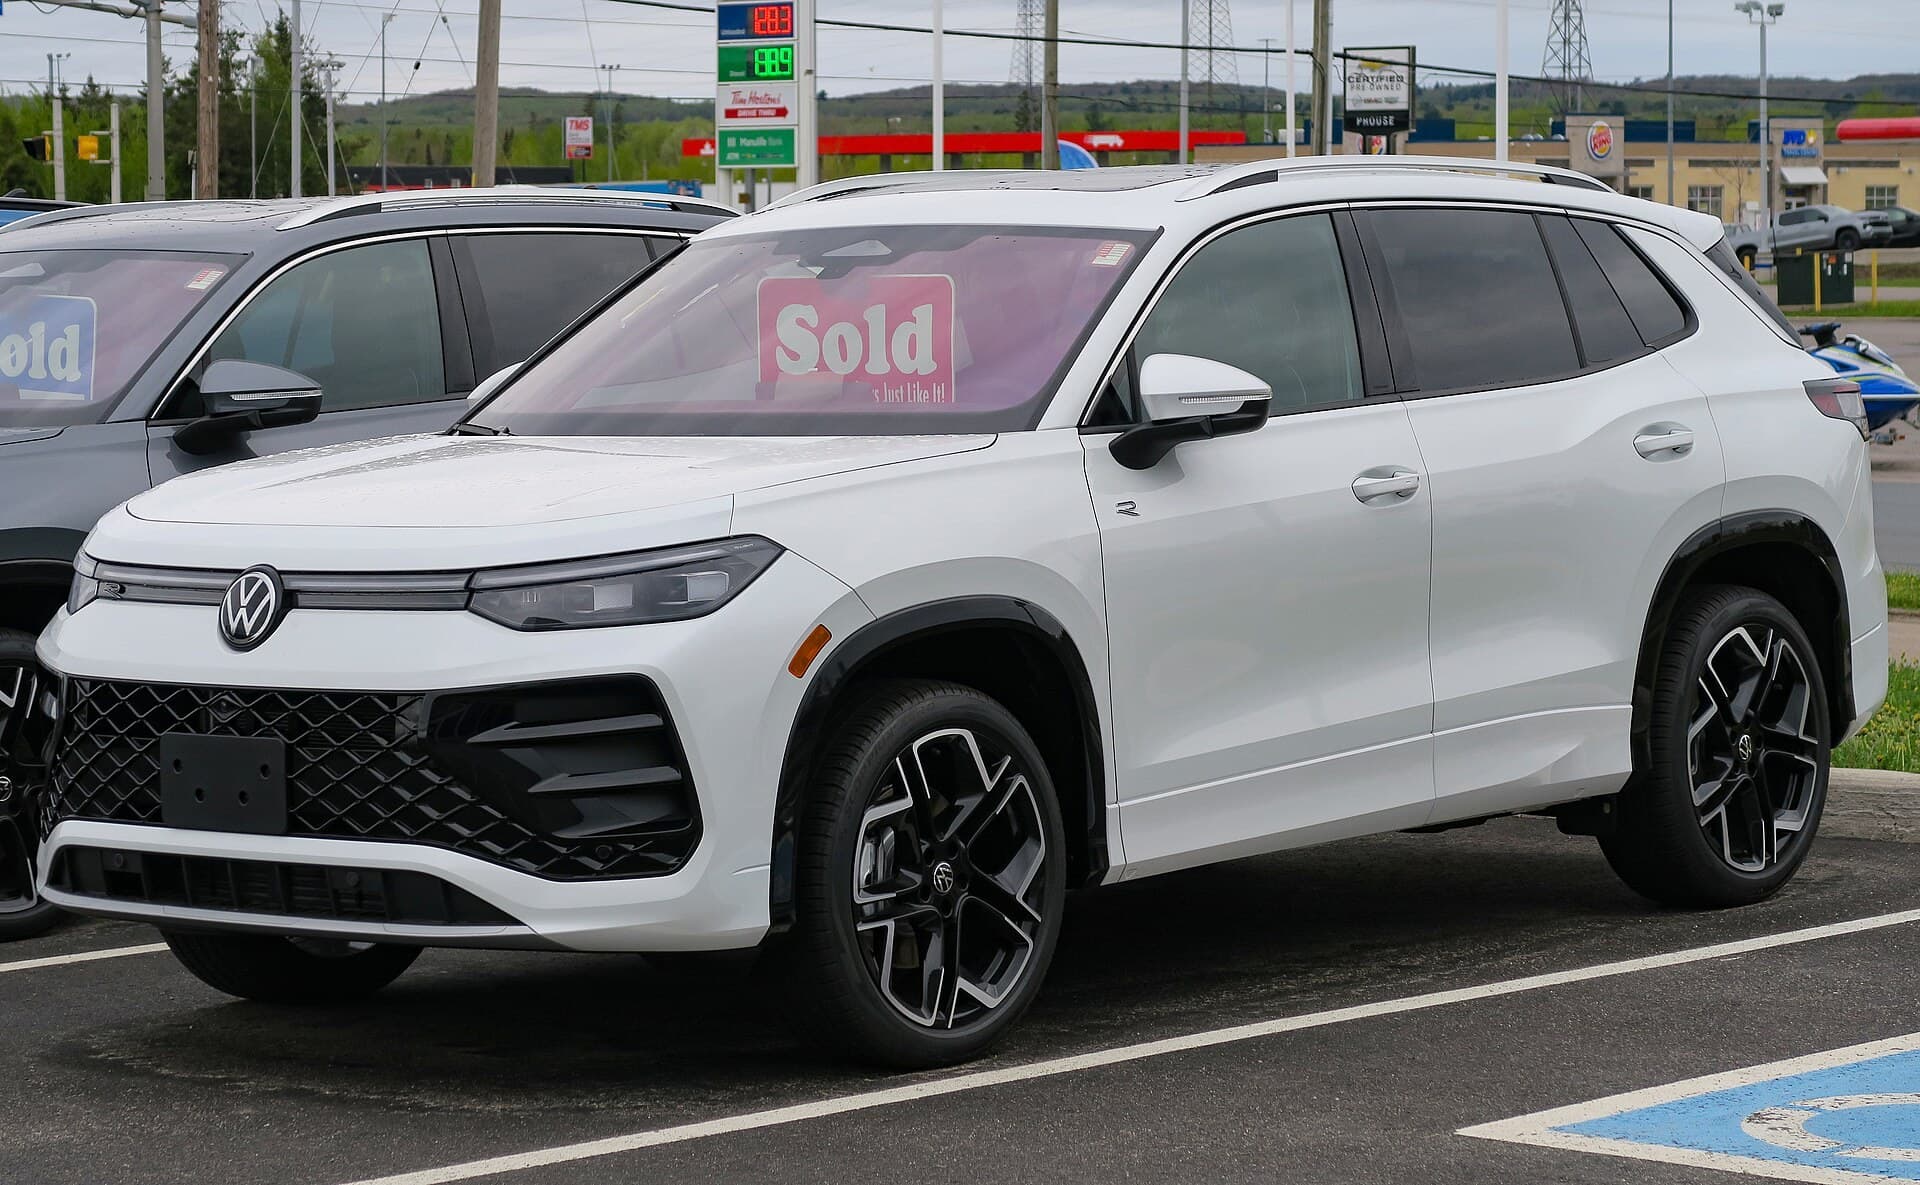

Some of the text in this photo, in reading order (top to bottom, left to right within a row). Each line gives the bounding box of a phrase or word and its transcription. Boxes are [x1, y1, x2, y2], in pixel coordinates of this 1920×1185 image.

[1347, 74, 1404, 83] CERTIFIED
[775, 303, 938, 375] Sold
[884, 381, 904, 403] Just
[907, 381, 930, 403] Like
[933, 382, 945, 403] It!
